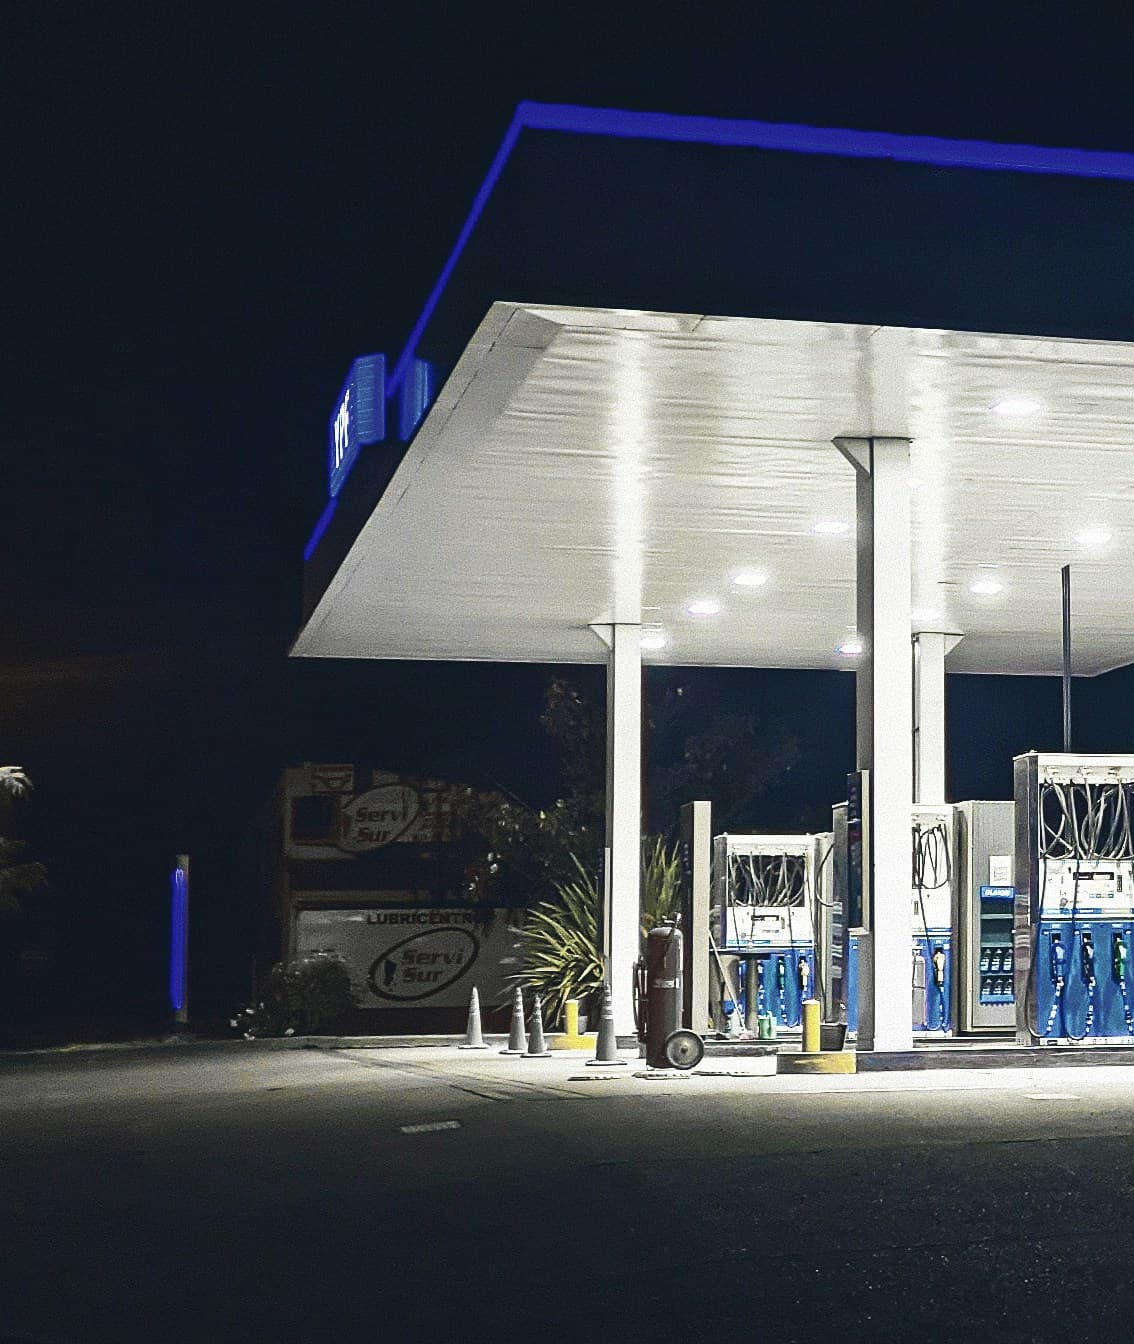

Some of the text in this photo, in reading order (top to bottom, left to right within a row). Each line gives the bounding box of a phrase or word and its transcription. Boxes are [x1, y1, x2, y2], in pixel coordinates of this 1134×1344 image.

[355, 805, 409, 823] Servi
[356, 827, 392, 843] Sur
[367, 912, 483, 925] LUBRICENTR
[401, 949, 464, 966] Servi
[402, 966, 443, 984] Sur
